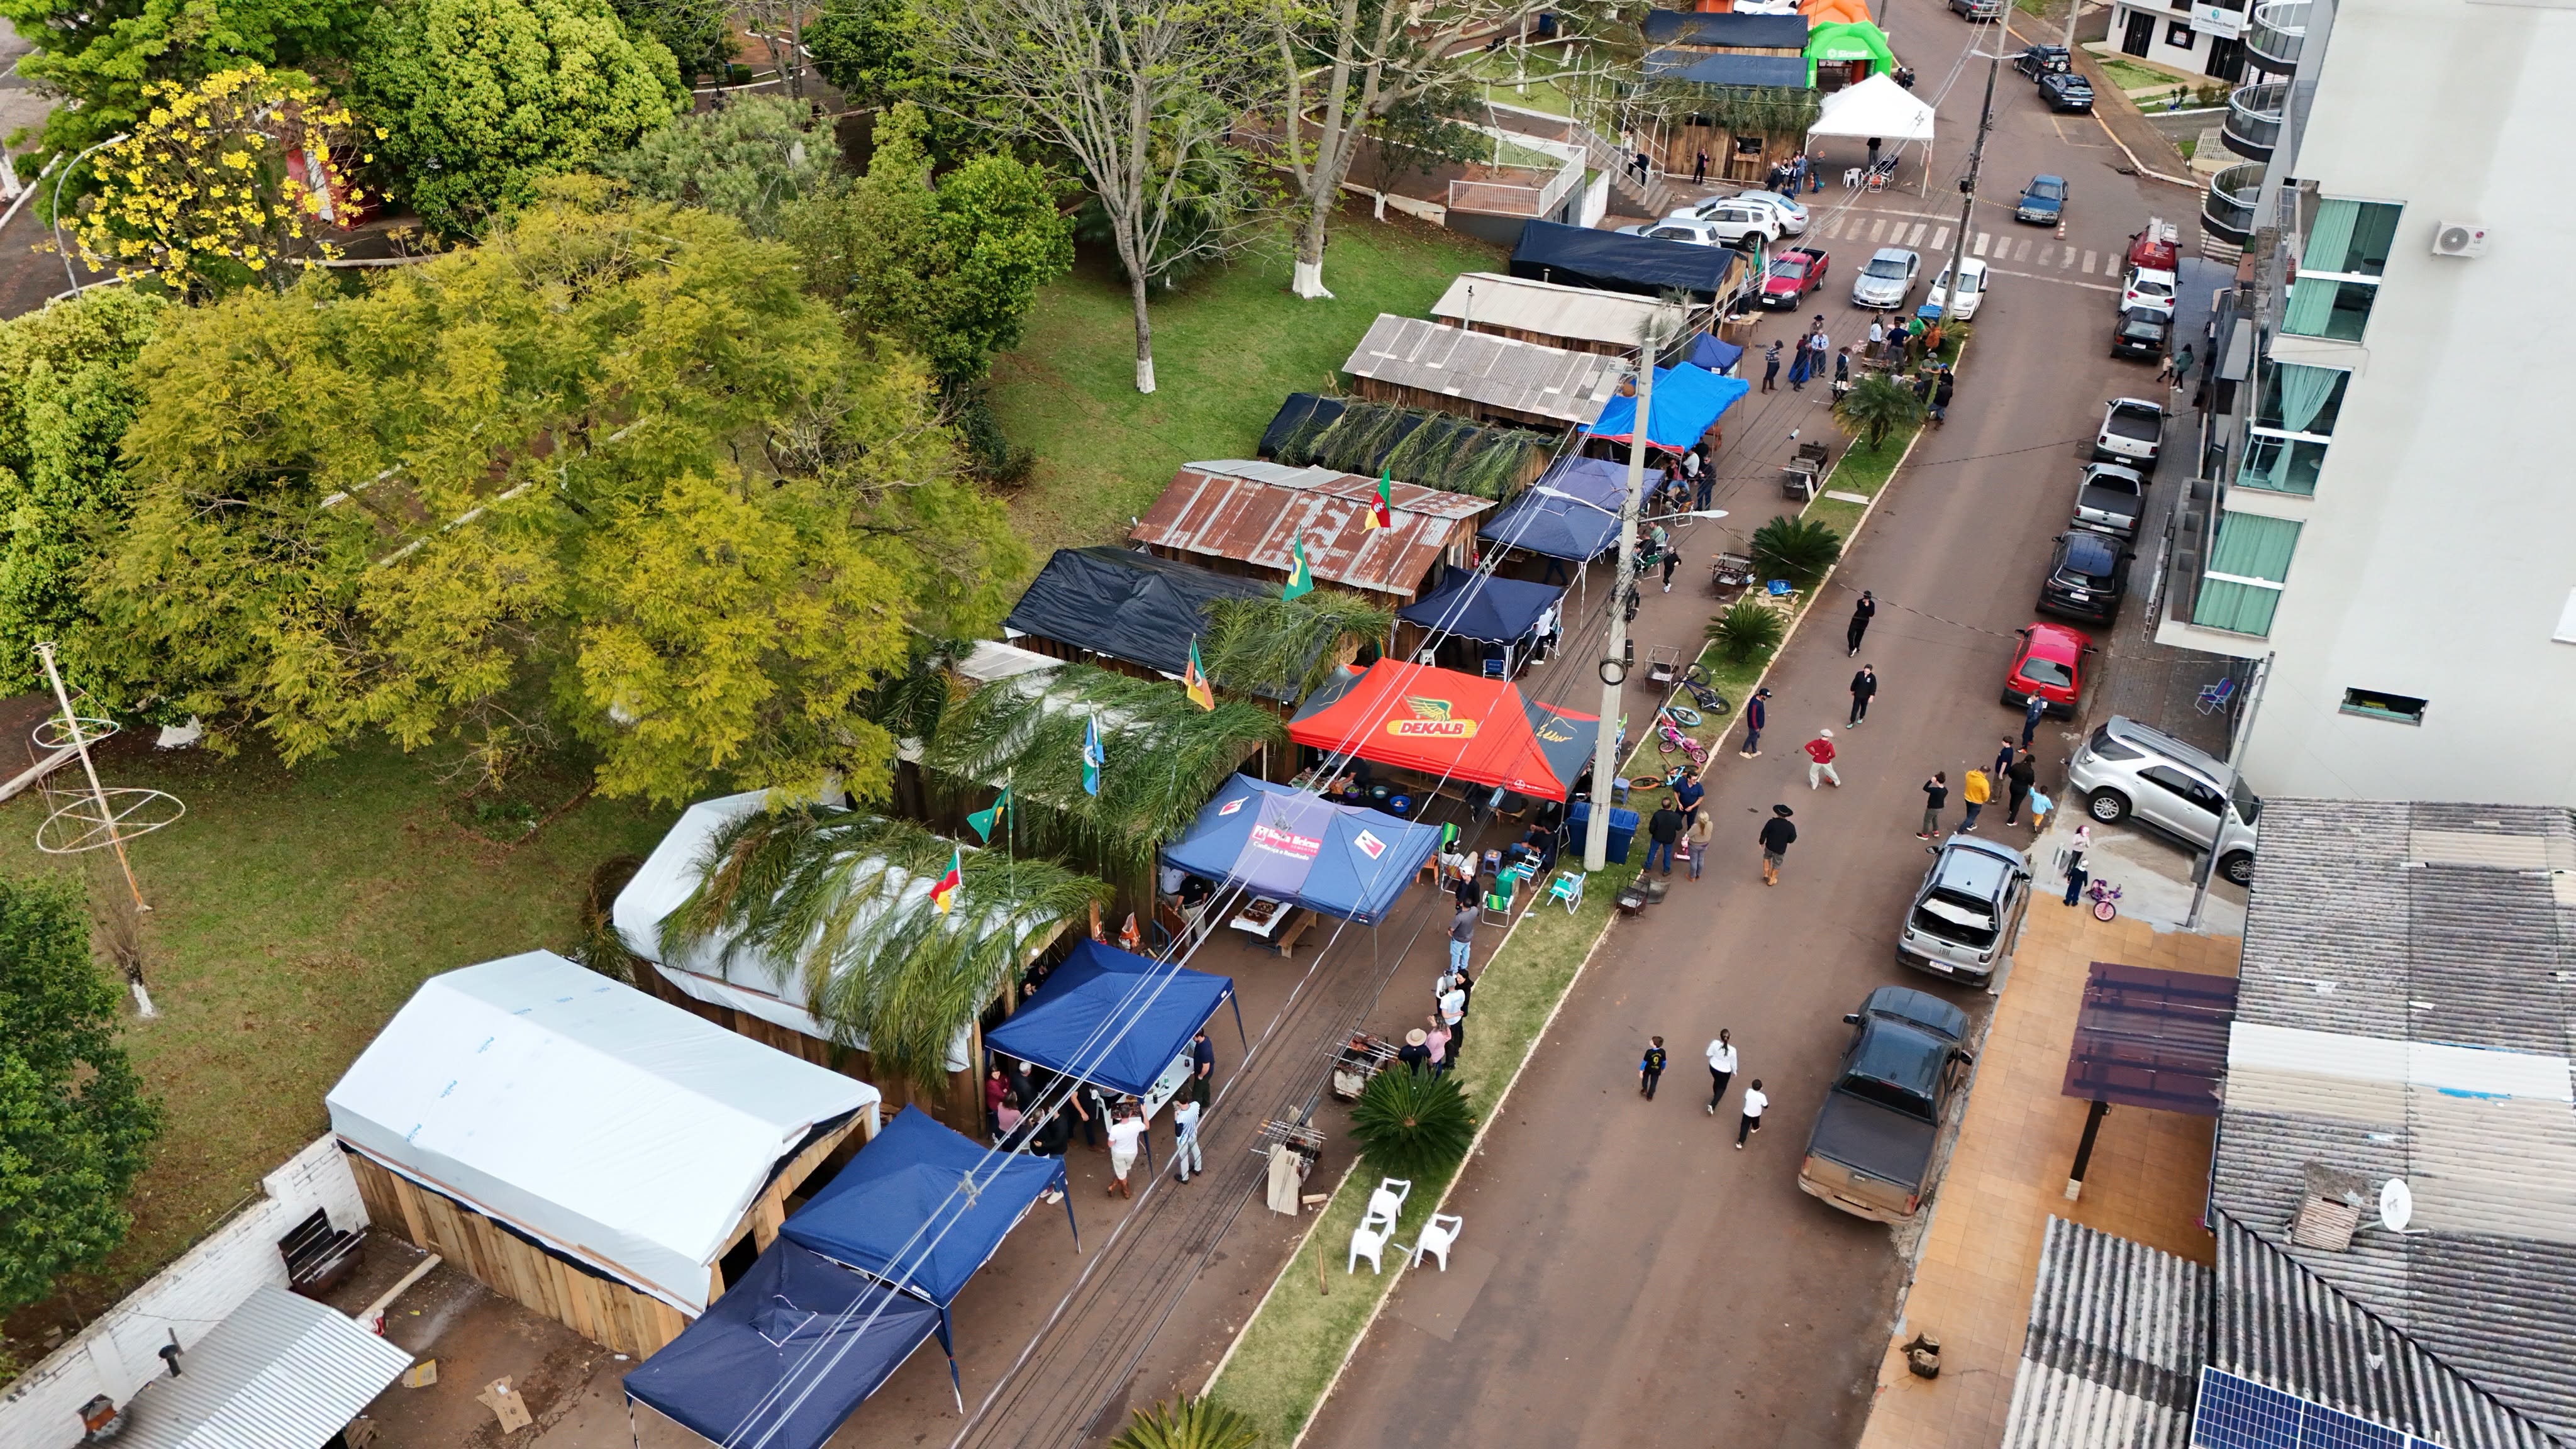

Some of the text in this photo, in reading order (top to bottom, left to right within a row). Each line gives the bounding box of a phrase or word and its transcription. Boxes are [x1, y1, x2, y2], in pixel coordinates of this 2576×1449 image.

[1399, 721, 1465, 735] DEKALB
[1292, 835, 1320, 849] Helena
[1284, 850, 1309, 860] Resultado
[1653, 1056, 1659, 1065] 9
